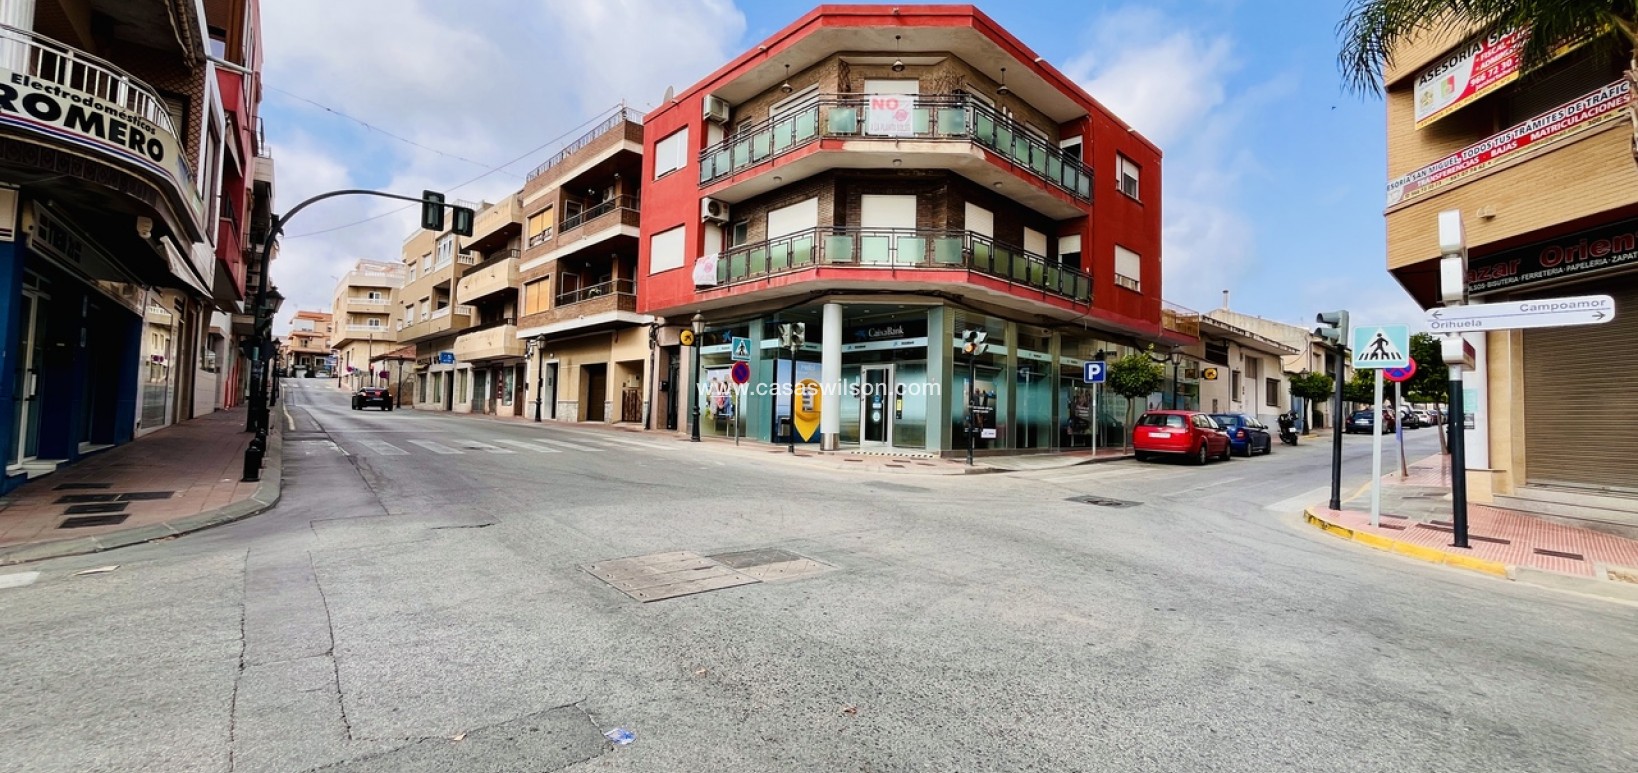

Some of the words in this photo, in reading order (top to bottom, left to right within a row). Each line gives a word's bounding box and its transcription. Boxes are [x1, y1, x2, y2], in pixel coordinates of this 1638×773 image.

[1488, 67, 1499, 77] 72
[11, 72, 155, 135] Electrodomésticos
[872, 97, 899, 110] NO
[0, 83, 164, 162] ROMERO
[1413, 171, 1427, 182] SAN
[1462, 141, 1492, 159] TODOS
[1495, 133, 1512, 146] TUS
[1567, 103, 1583, 115] DE
[1586, 80, 1629, 107] TRÁFIC
[1417, 157, 1479, 187] TRANSFERENCIAS
[1490, 142, 1518, 158] BAJAS
[1530, 94, 1630, 141] MATRICULACIONES
[1467, 258, 1521, 283] azar
[1539, 231, 1637, 268] Orien
[1521, 267, 1564, 281] FERRETERIA
[1566, 258, 1608, 272] PAPELERIA
[1611, 252, 1638, 264] ZAPAT
[1519, 299, 1606, 313] Campoamor
[868, 325, 904, 337] CaixaBank
[1431, 319, 1483, 330] Orihuela
[1088, 363, 1102, 380] P
